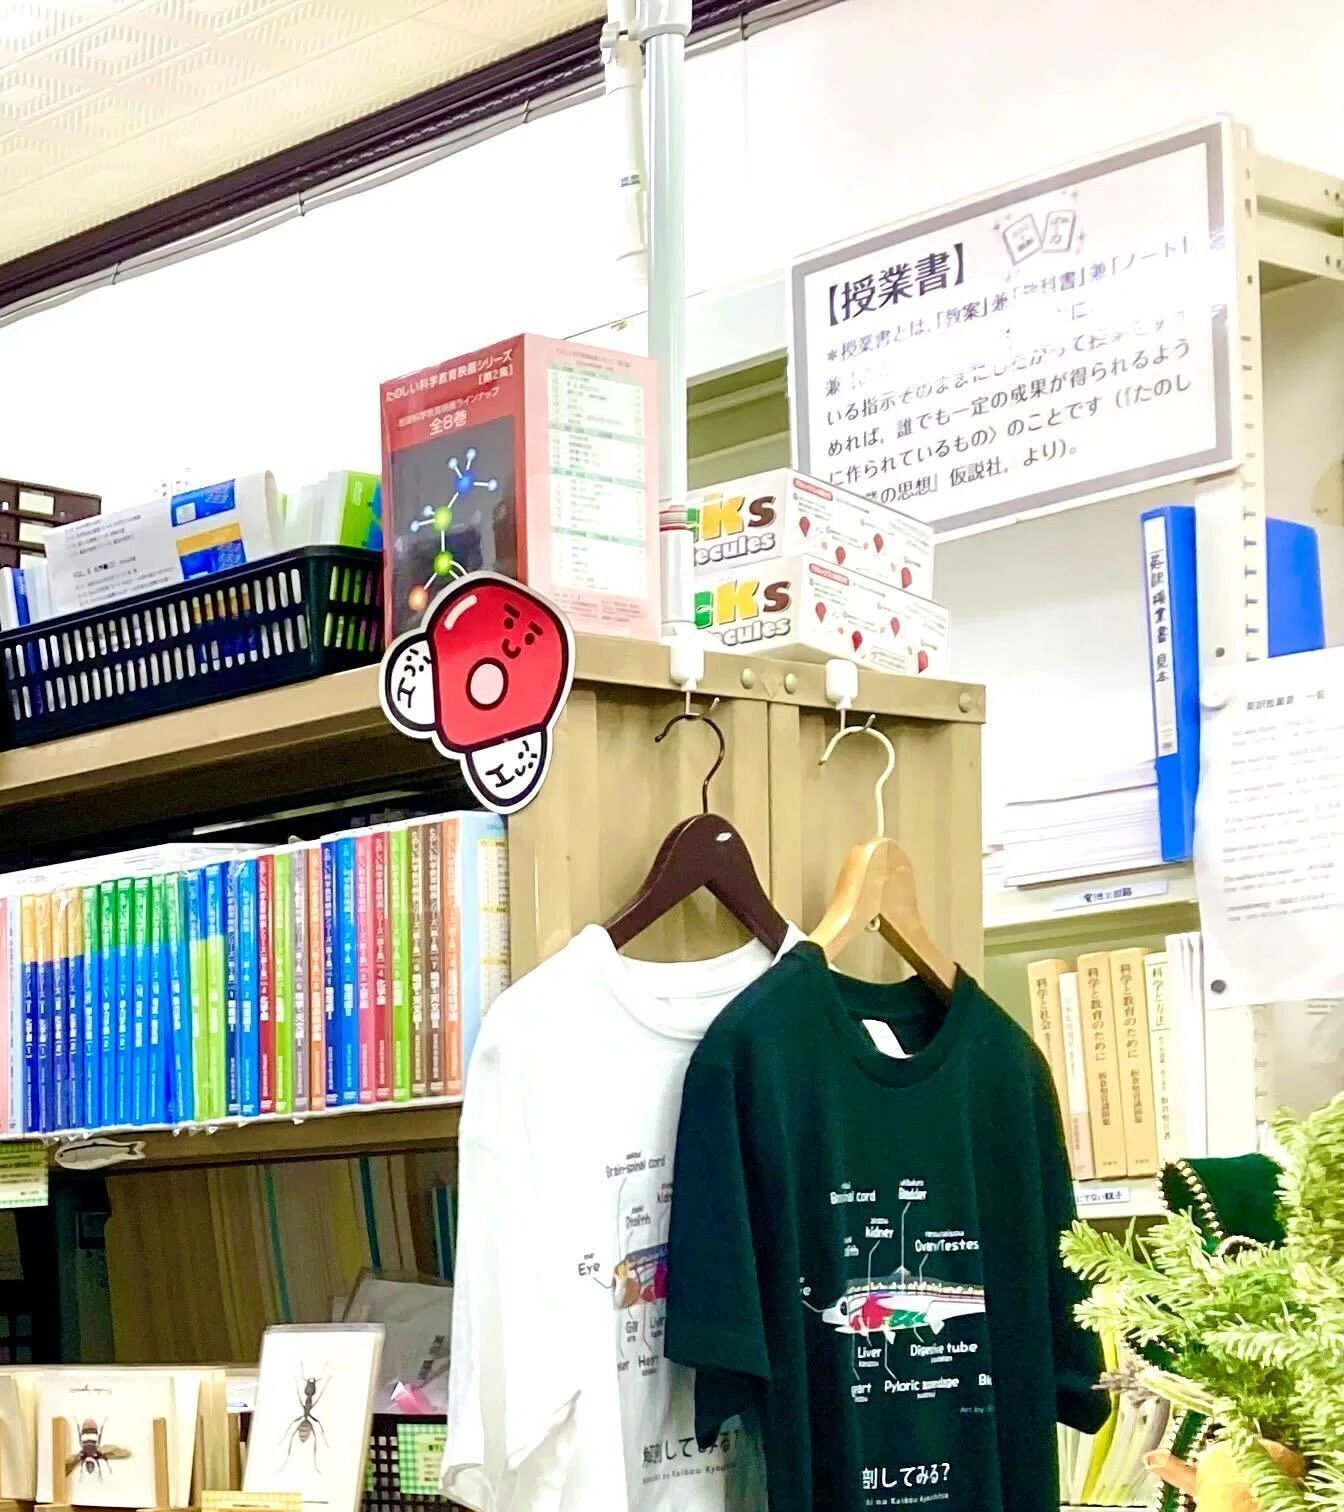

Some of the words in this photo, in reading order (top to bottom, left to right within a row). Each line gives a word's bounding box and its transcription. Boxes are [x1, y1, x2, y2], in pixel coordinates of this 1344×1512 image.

[827, 243, 964, 327] 【授業書】
[428, 409, 468, 437] 全8巻
[578, 1261, 601, 1277] Eye
[858, 1346, 882, 1359] Liver
[946, 1341, 978, 1354] tube
